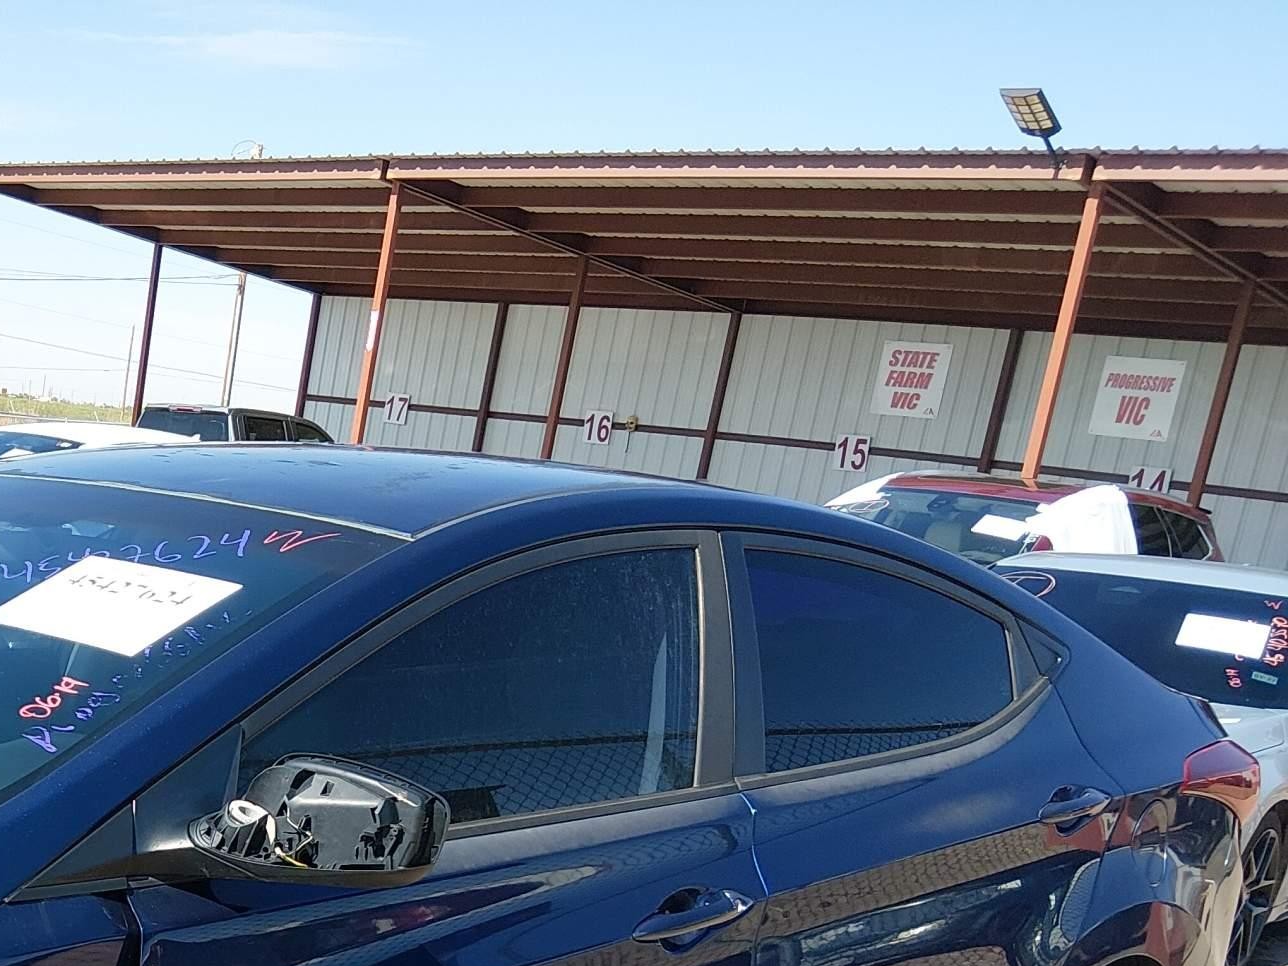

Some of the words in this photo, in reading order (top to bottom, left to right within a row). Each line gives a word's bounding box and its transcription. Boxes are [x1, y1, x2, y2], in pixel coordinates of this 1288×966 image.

[888, 349, 940, 370] STATE
[884, 370, 934, 390] FARM
[1104, 372, 1176, 393] PROGRESSIVE
[385, 396, 409, 422] 17
[890, 391, 921, 410] VIC
[1115, 395, 1151, 426] VIC
[585, 413, 610, 443] 16
[838, 437, 868, 470] 15
